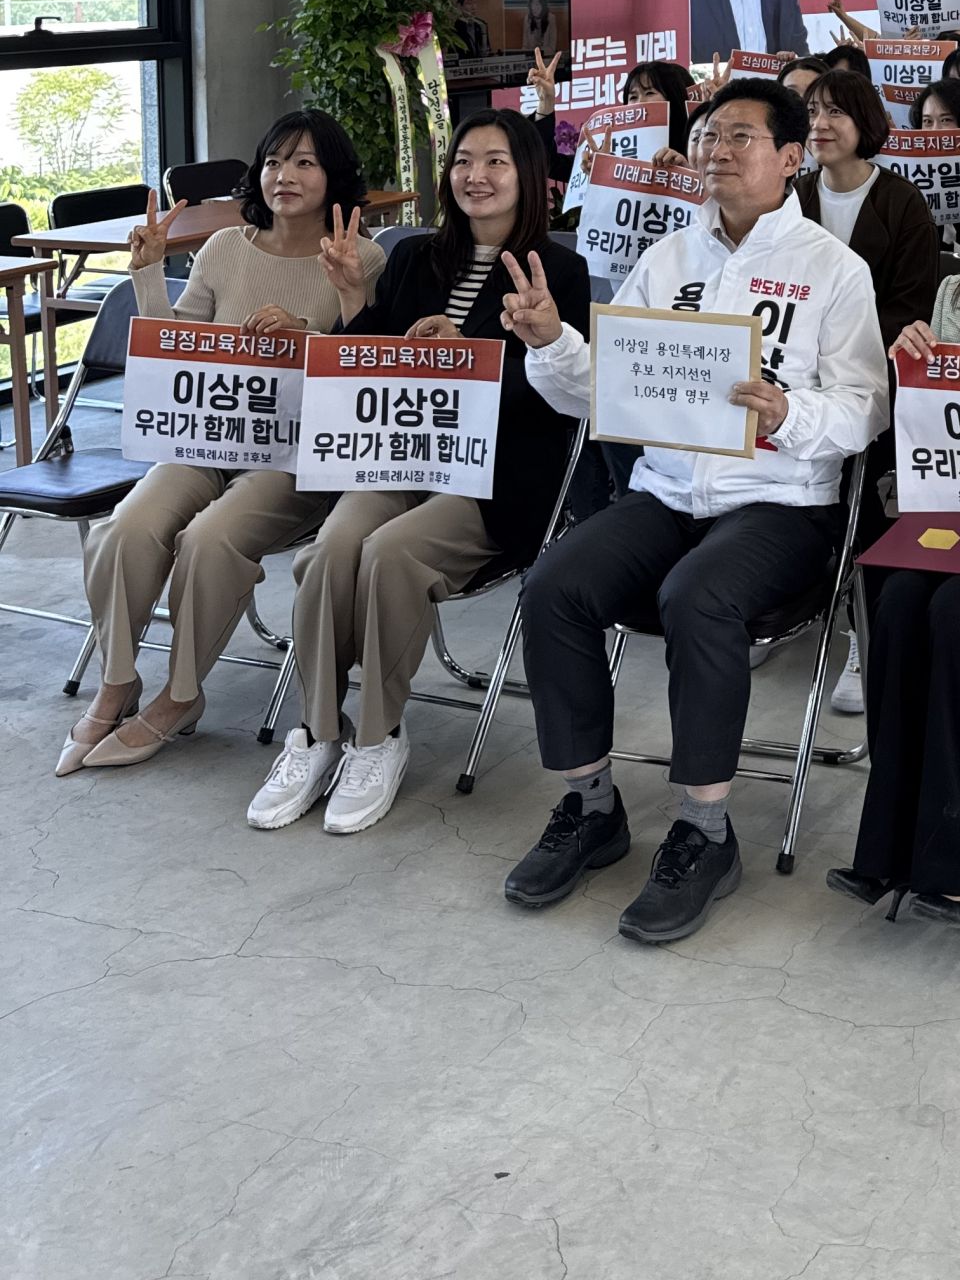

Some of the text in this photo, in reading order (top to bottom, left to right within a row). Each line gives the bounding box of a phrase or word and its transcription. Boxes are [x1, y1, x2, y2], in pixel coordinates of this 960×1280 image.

[883, 10, 960, 26] 우리가 함께 합니다
[636, 29, 677, 63] 미래
[876, 44, 941, 57] 미래교육전문가
[883, 64, 932, 84] 이상일
[427, 79, 446, 130] 당선을
[613, 163, 703, 197] 미래교육전문가
[615, 198, 692, 232] 이상일
[586, 228, 632, 257] 우리가
[749, 277, 812, 301] 반도체 키운
[158, 328, 297, 360] 열정교육지원가
[337, 345, 475, 370] 열정교육지원가
[613, 337, 732, 363] 이상일 용인특례시장
[630, 361, 713, 383] 후보 지지선언
[172, 369, 279, 415] 이상일
[633, 384, 711, 404] 1,054명 명부
[354, 386, 460, 429] 이상일
[134, 408, 300, 446] 우리가 함께 합니
[174, 446, 239, 463] 용인특례시장
[312, 431, 488, 468] 우리가 함께 합니다
[354, 469, 425, 485] 용인특례시장
